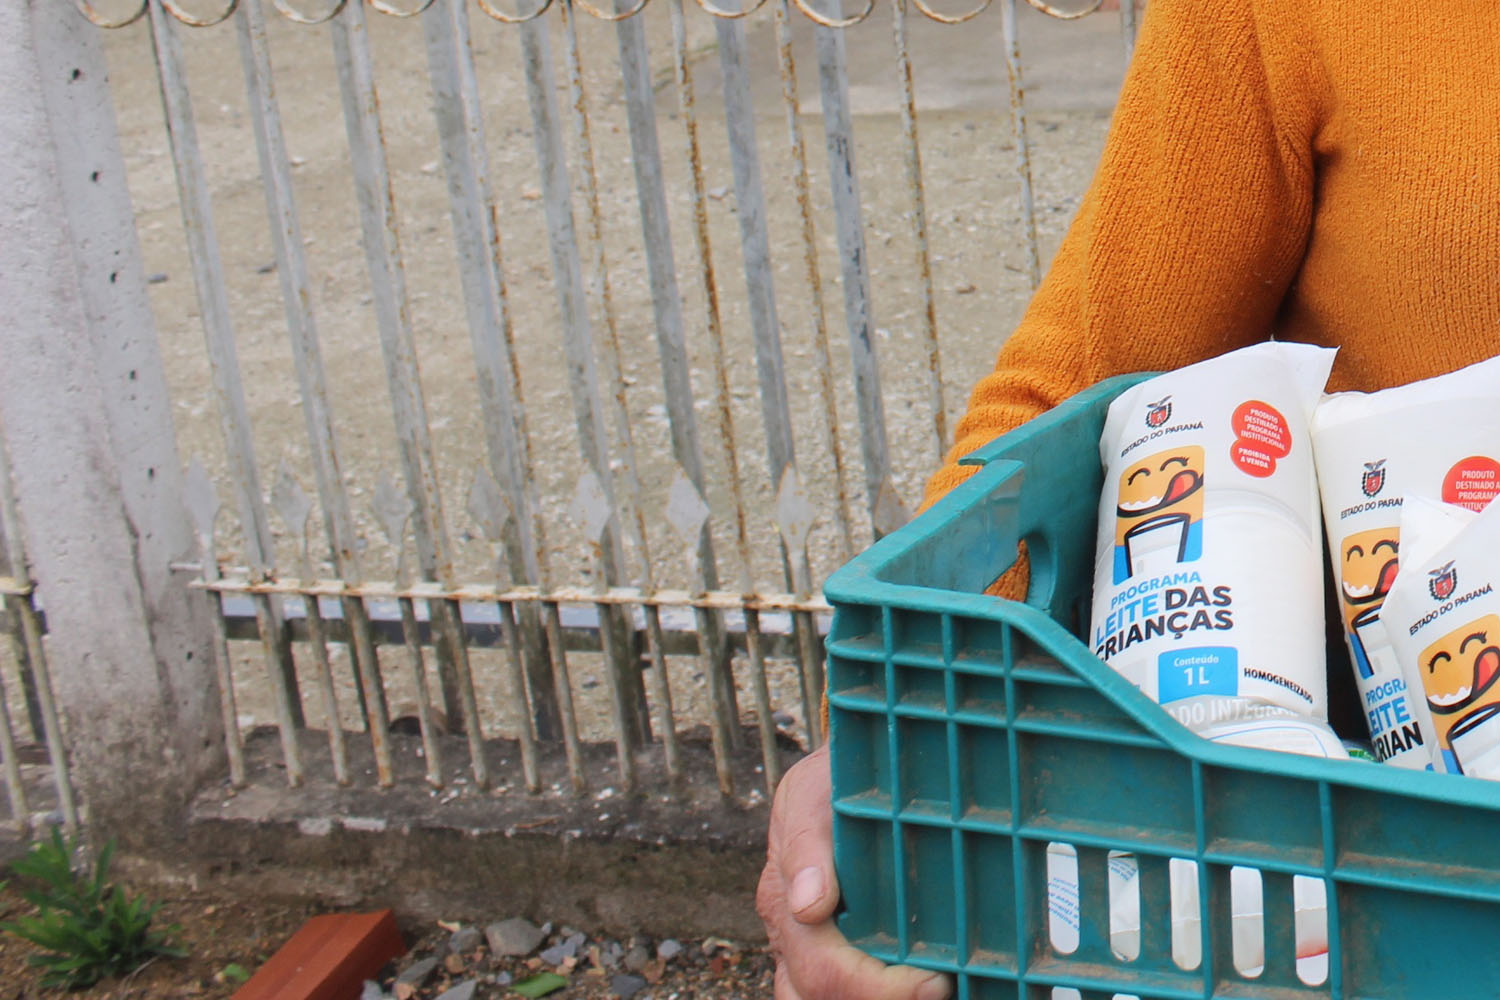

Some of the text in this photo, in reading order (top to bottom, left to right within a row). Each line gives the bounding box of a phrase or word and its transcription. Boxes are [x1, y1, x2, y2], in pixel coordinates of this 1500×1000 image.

[1244, 415, 1278, 431] DESTINADO
[1250, 408, 1279, 424] PRODUTO
[1120, 421, 1204, 458] ESTADO DO PARANÁ
[1240, 430, 1285, 451] INSTITUCIONAL
[1246, 423, 1281, 440] PROGRAMA
[1238, 447, 1271, 462] PROIBIDA
[1246, 457, 1269, 469] VENDA
[1461, 470, 1495, 479] PRODUTO
[1455, 481, 1500, 490] DESTINADO A
[1340, 503, 1364, 520] ESTADO
[1365, 501, 1377, 511] DO
[1111, 571, 1202, 610] PROGRAMA
[1096, 585, 1233, 647] LEITE DAS
[1409, 582, 1493, 636] ESTADO DO PARANÁ
[1173, 654, 1220, 667] Conteúdo
[1243, 667, 1314, 704] HOMOGENEIZADO
[1368, 696, 1411, 739] EITE
